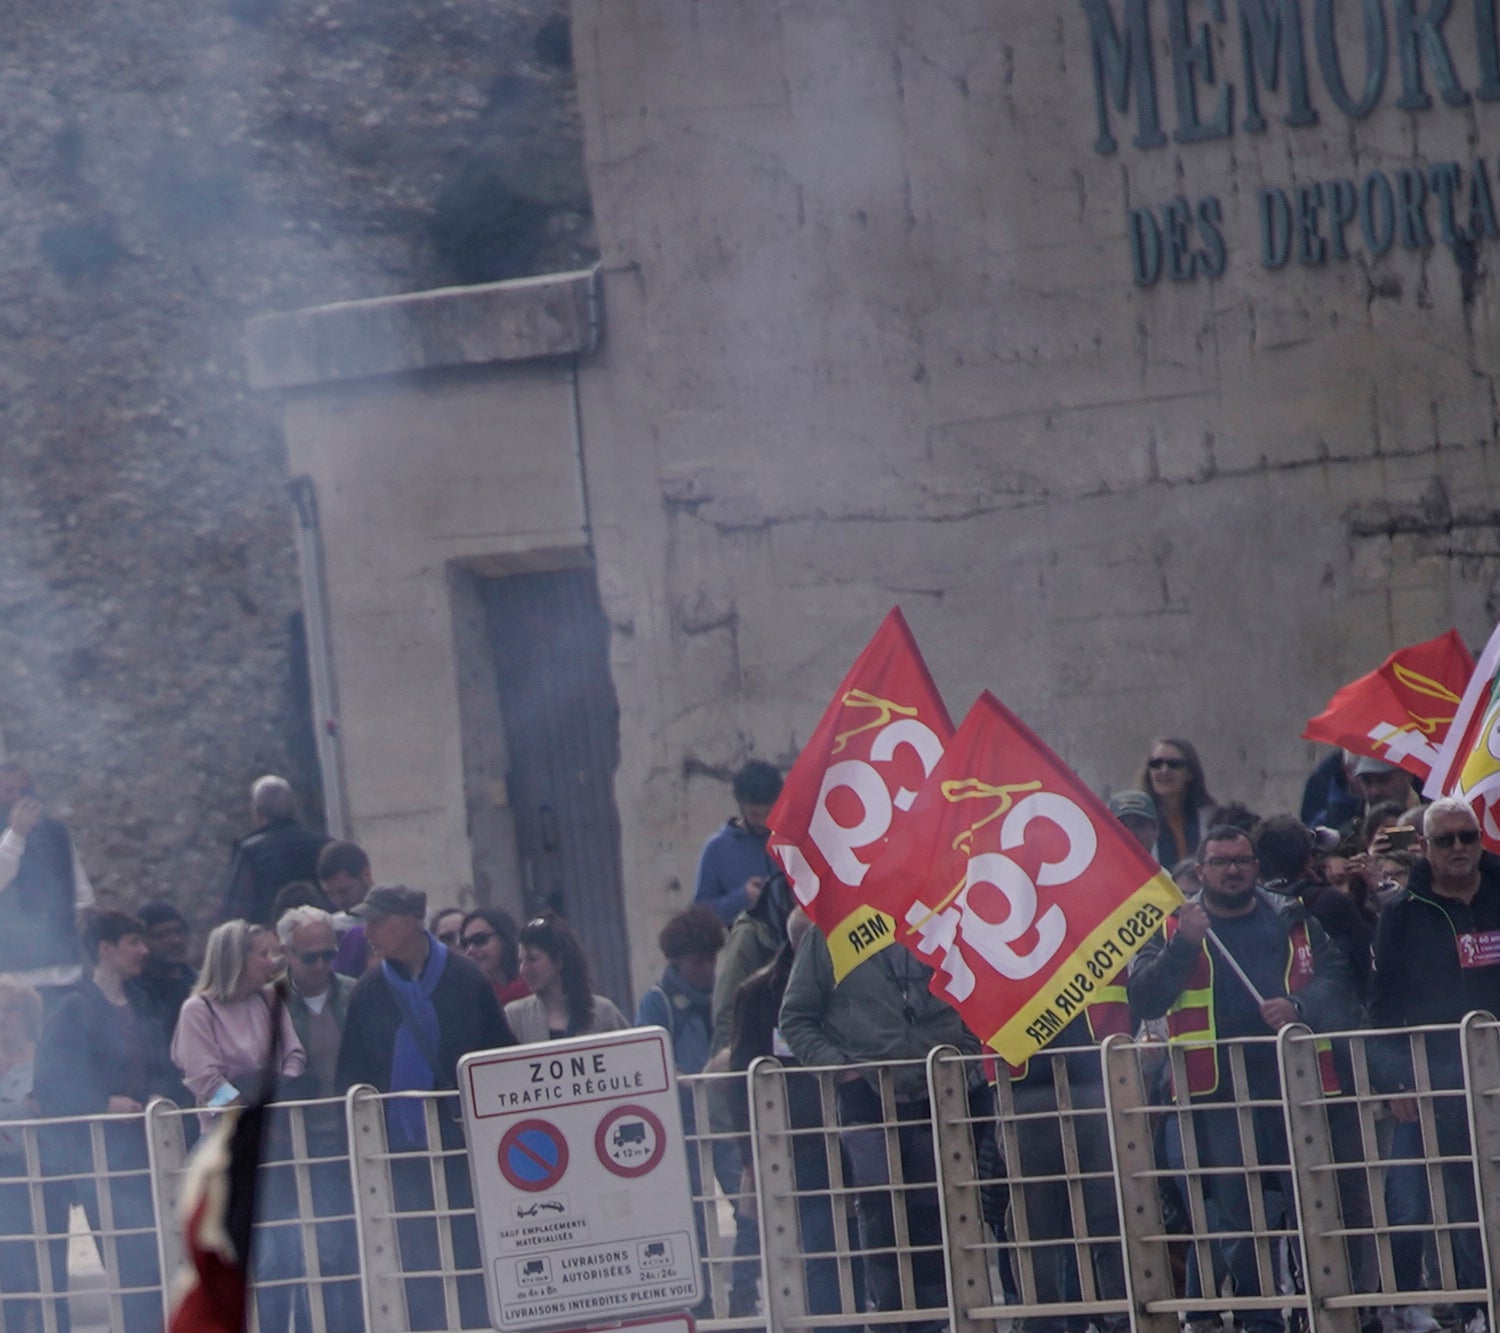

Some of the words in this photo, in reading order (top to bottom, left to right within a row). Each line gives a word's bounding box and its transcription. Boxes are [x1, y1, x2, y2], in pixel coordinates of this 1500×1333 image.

[1129, 195, 1227, 288] DES
[529, 1053, 607, 1083] ZONE
[498, 1085, 562, 1107] TRAFIC
[572, 1071, 644, 1097] RÉGULÉ
[499, 1228, 520, 1239] SAUF
[522, 1219, 587, 1236] EMPLACEMENTS
[515, 1231, 574, 1247] MATÉRIALISÉS
[561, 1250, 630, 1269] LIVRAISONS
[562, 1265, 632, 1284] AUTORISÉES
[505, 1303, 567, 1320] LIVRAISONS
[568, 1293, 629, 1311] INTERDITES
[630, 1286, 668, 1303] PLEINE
[669, 1282, 695, 1297] VOIE
